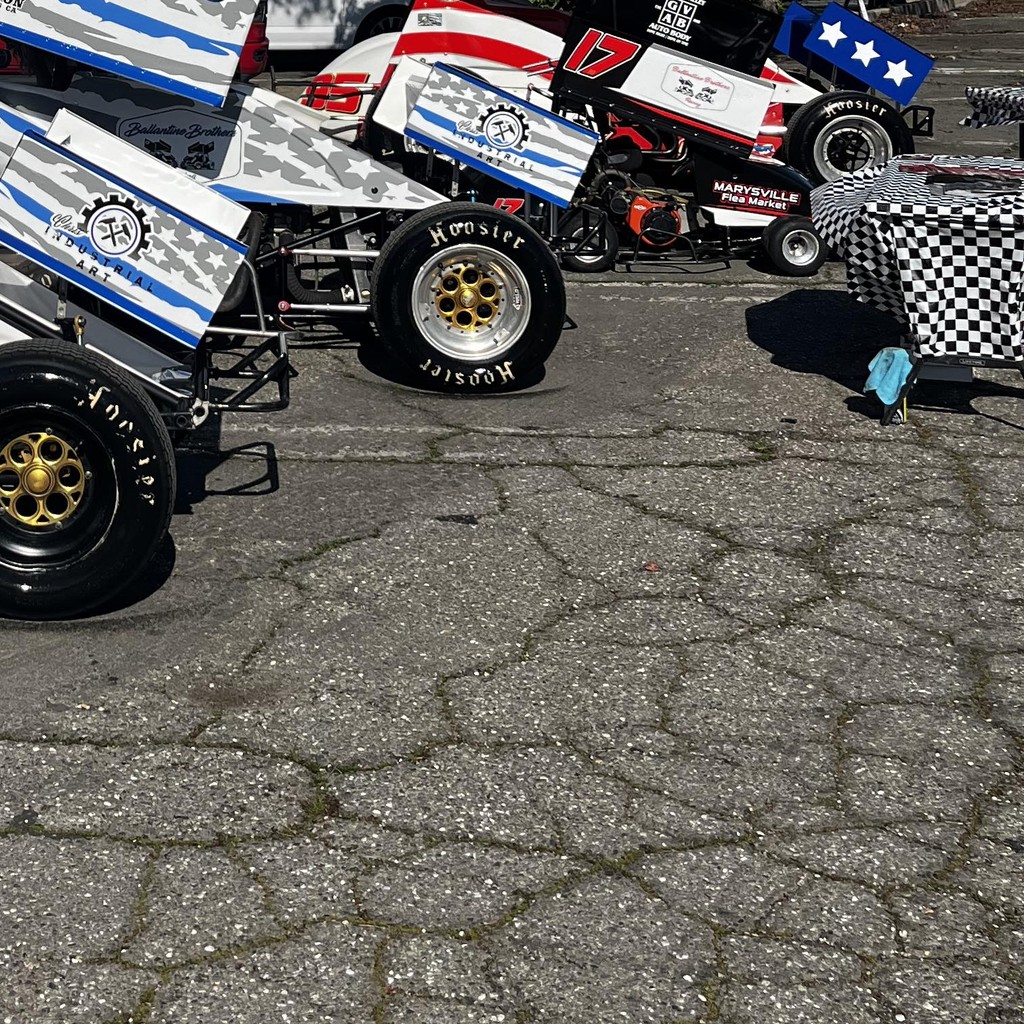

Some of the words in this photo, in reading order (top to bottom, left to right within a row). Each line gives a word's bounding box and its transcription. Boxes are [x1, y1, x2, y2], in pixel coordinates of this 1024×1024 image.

[6, 6, 16, 14] CA
[668, 0, 678, 11] G
[683, 5, 693, 15] V
[661, 13, 672, 24] A
[676, 17, 687, 29] B
[648, 23, 670, 34] AUTO
[669, 29, 692, 42] BODY
[563, 28, 642, 79] 17
[824, 100, 887, 118] Hoosier
[124, 123, 186, 138] Ballantine
[185, 124, 237, 139] Brothers
[477, 151, 502, 166] ART
[714, 182, 799, 202] MARYSVILLE
[721, 193, 745, 203] Flea
[748, 197, 787, 210] Market
[429, 221, 525, 249] Hoosier
[45, 226, 153, 292] INDUSTRIAL
[76, 260, 111, 282] ART
[420, 358, 516, 386] Hoosier
